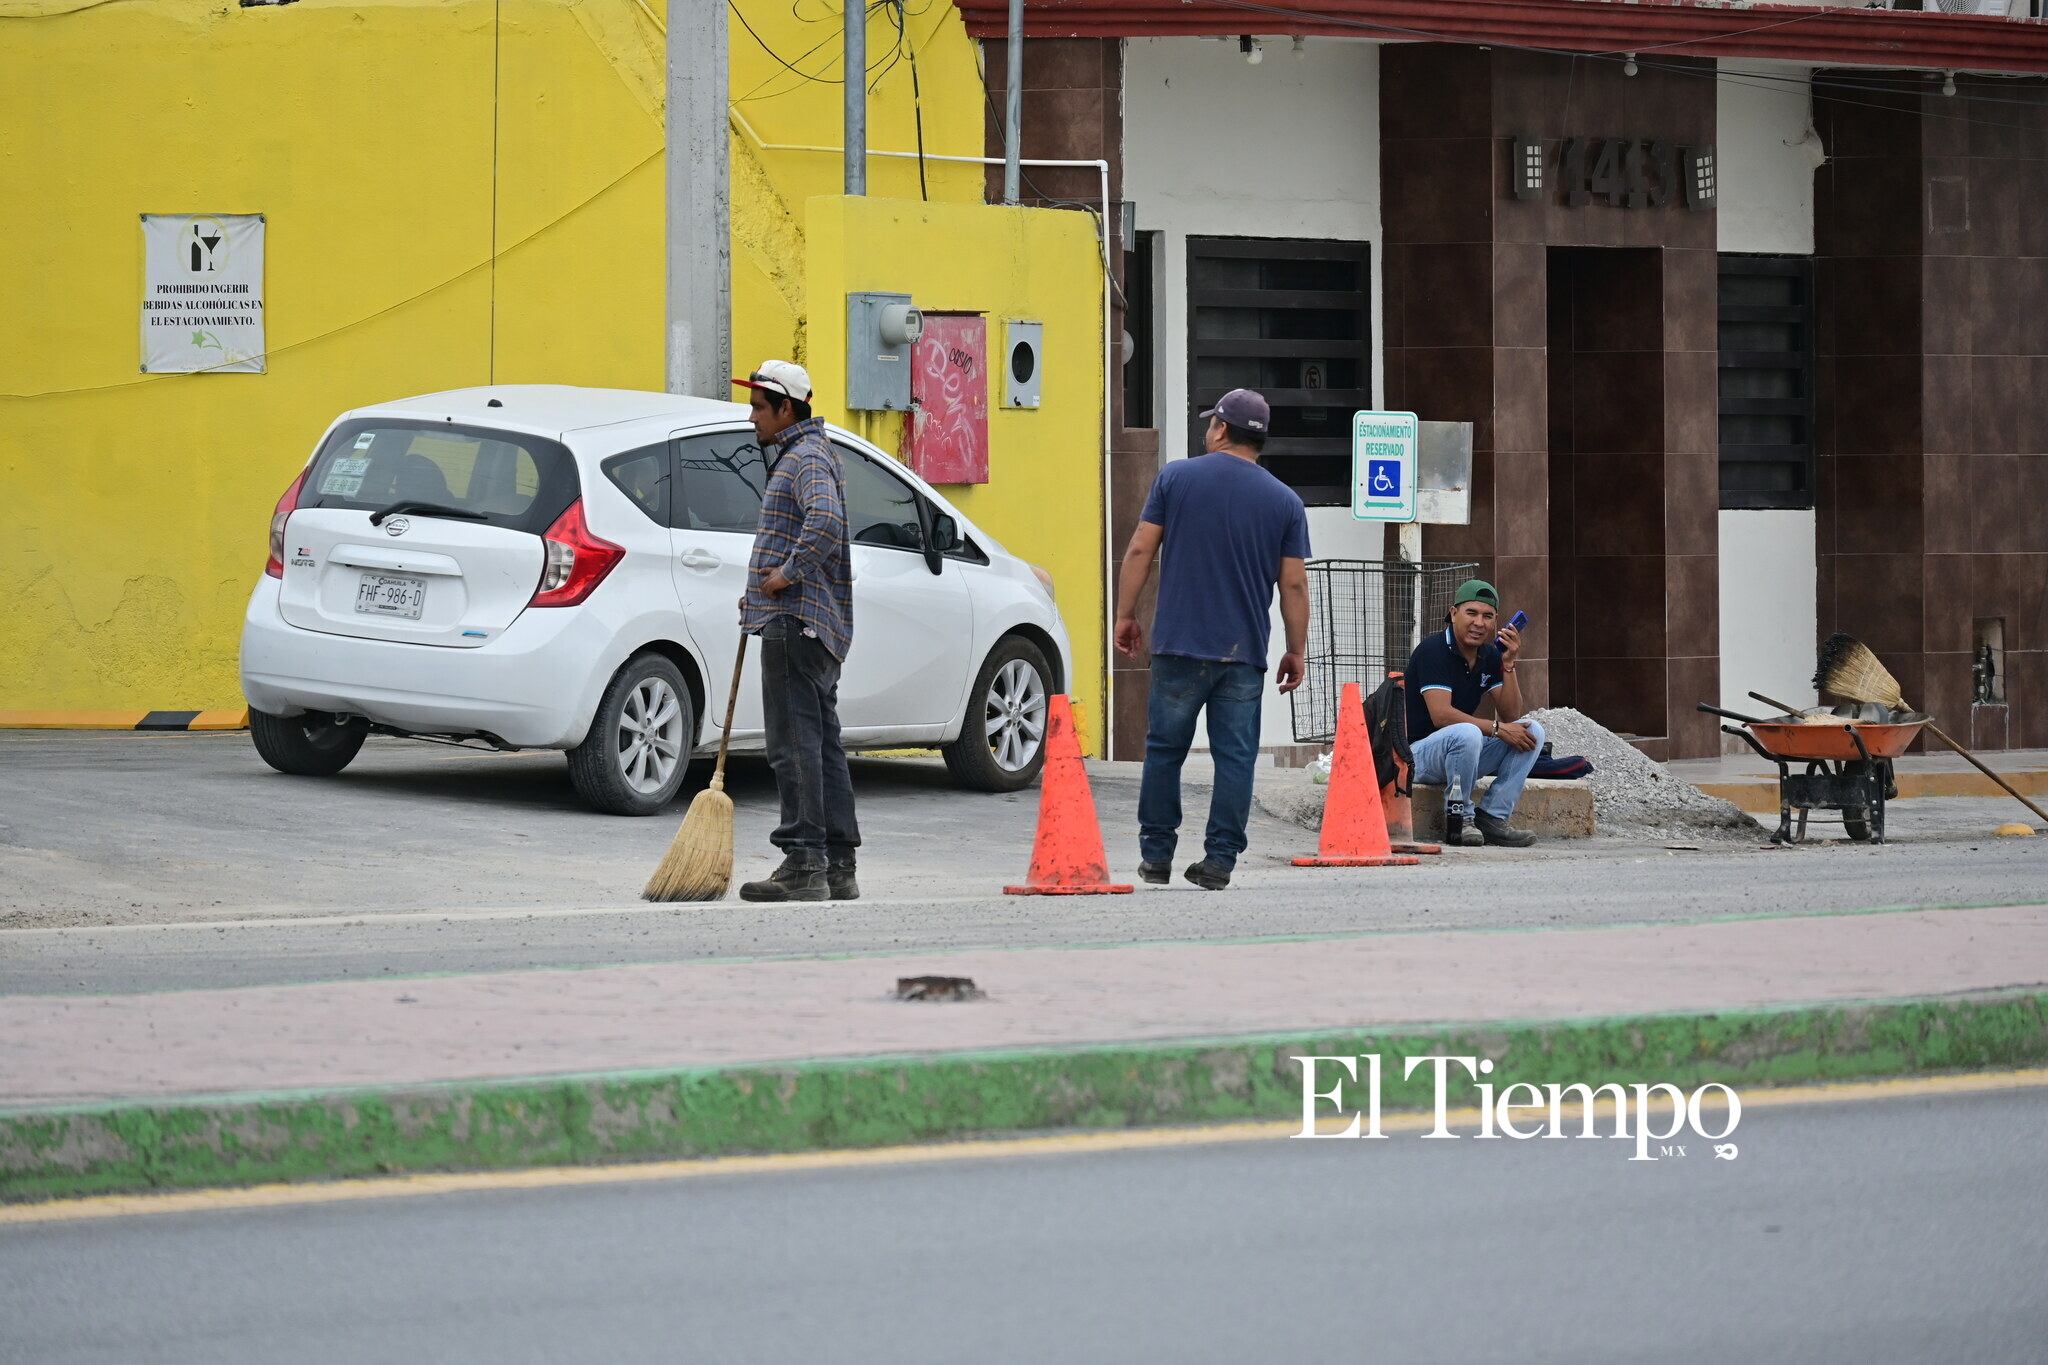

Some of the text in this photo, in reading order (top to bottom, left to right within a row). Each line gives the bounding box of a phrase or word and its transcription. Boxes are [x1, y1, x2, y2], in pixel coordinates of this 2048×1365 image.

[1566, 134, 1678, 208] 1413
[156, 284, 249, 294] PROHIBIDO INGERIR
[143, 298, 263, 310] BEBIDAS ALCOHÓLICAS EN
[151, 316, 255, 326] EL ESTACIONAMIENTO.
[1359, 425, 1412, 438] ESTACIONAMIENTO
[1366, 442, 1404, 456] RESERVADO
[358, 583, 421, 607] FHF-986-D
